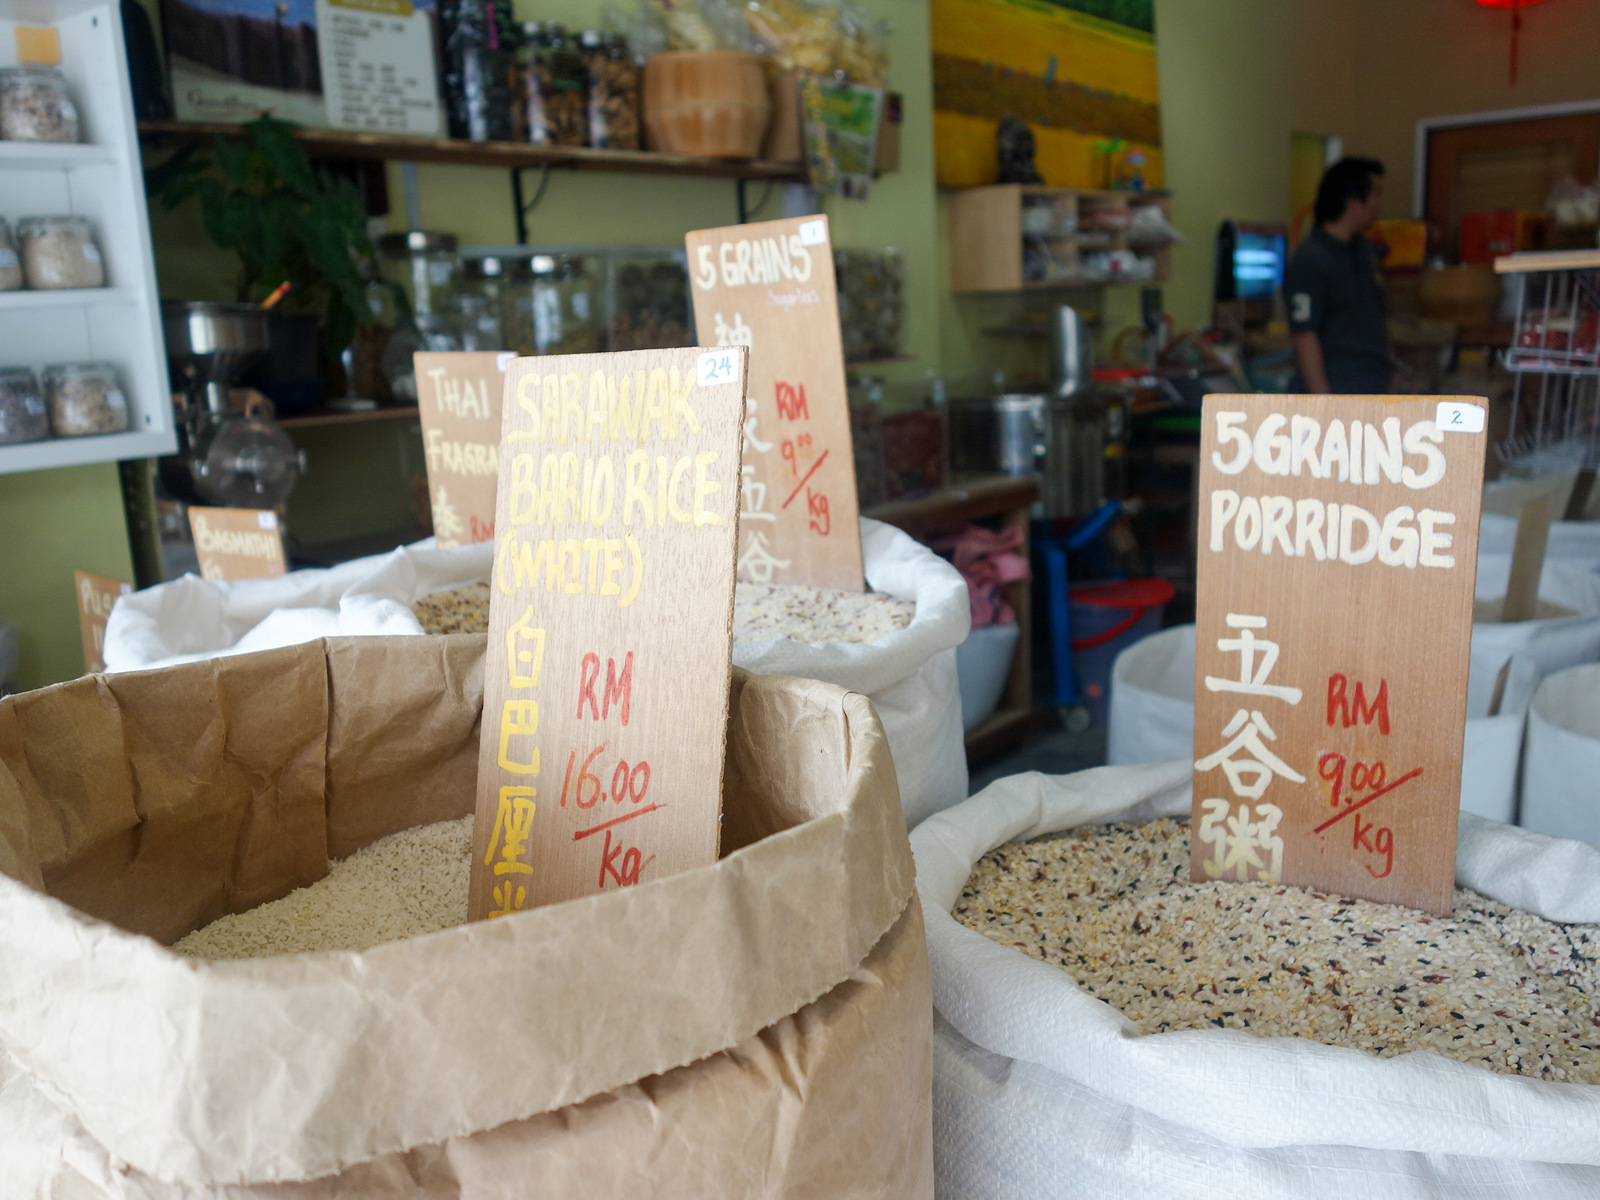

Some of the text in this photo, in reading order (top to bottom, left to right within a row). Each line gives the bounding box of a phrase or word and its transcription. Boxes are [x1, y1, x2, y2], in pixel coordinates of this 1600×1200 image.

[696, 234, 812, 291] 5 GRAINS
[427, 366, 491, 420] THAI
[704, 355, 733, 381] 24
[507, 365, 700, 446] SARAWAK
[774, 381, 810, 422] RM
[1450, 409, 1464, 425] 2
[427, 429, 500, 477] FRAGRA
[509, 448, 723, 529] BARIO RICE
[1210, 489, 1456, 569] PORRIDGE
[497, 529, 643, 609] (WHITE)
[576, 650, 634, 727] RM
[1326, 672, 1390, 736] RM
[560, 745, 651, 810] 16.00
[1194, 612, 1306, 886] 五谷粥
[1353, 813, 1394, 879] kg
